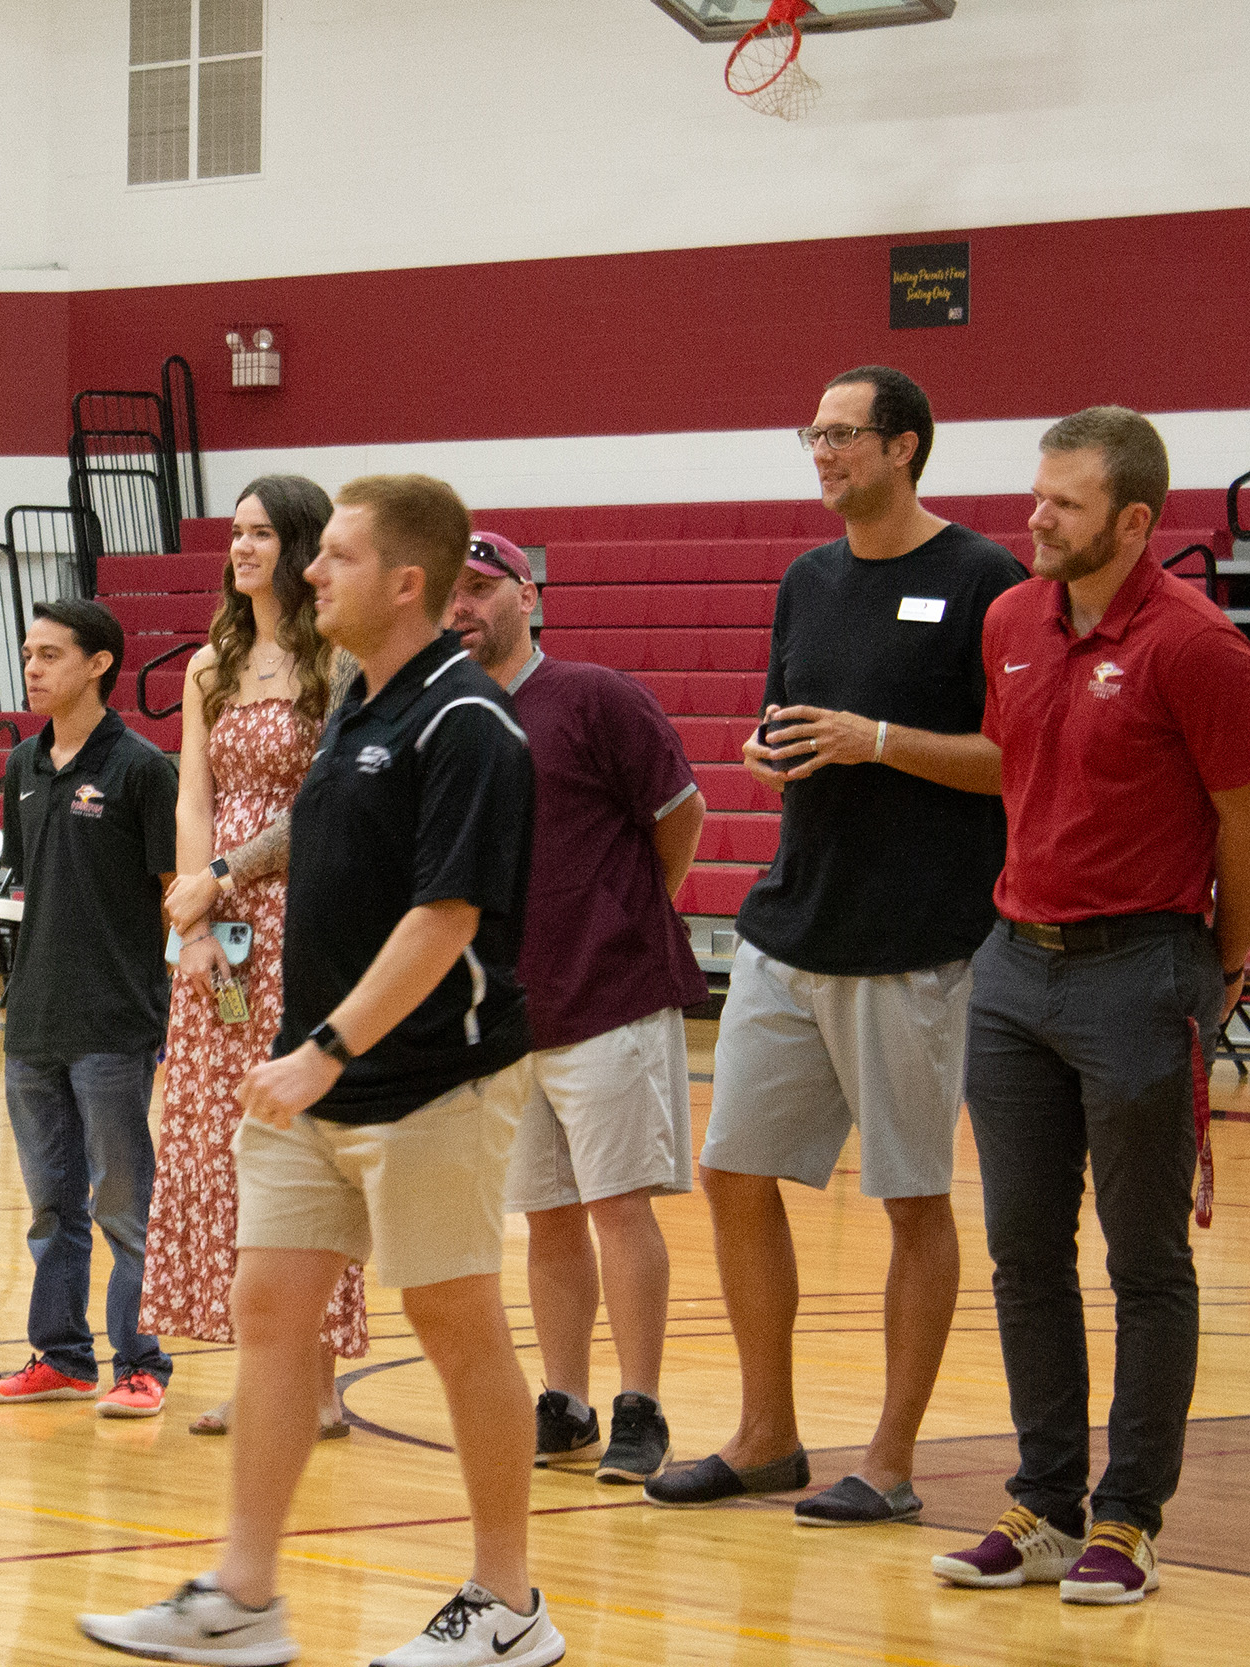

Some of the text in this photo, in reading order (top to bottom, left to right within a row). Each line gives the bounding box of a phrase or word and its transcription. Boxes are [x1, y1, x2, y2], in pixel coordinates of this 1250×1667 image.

[918, 268, 944, 281] Parents
[950, 266, 967, 279] Fans
[906, 286, 951, 305] Seating Only
